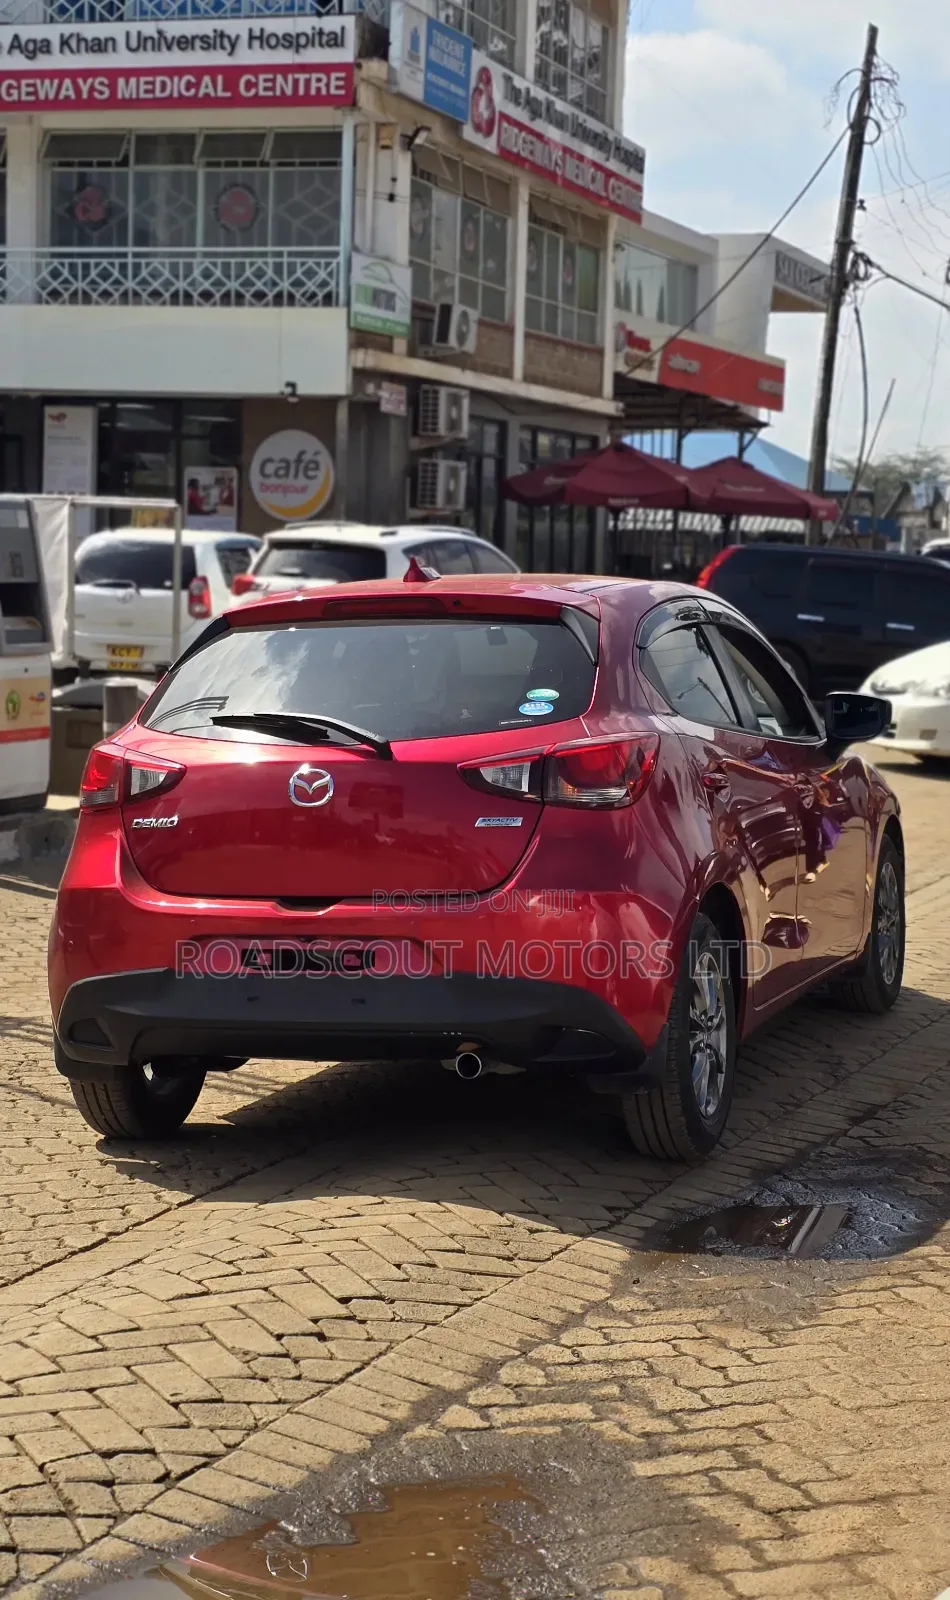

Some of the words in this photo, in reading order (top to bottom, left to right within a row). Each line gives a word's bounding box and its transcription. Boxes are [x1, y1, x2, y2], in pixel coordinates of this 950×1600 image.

[7, 33, 51, 60] Aga
[59, 33, 116, 54] Khan
[125, 28, 240, 56] University
[248, 26, 346, 54] Hospital
[117, 75, 232, 99] MEDICAL
[238, 72, 346, 97] CENTRE
[502, 72, 523, 107] The
[523, 86, 544, 122] Aga
[544, 96, 570, 133] Khan
[570, 111, 613, 162] University
[612, 136, 645, 175] Hospital
[501, 120, 564, 177] RIDGEWAYS
[565, 154, 607, 197] MEDICAL
[259, 450, 321, 481] café
[260, 482, 309, 498] bonjour
[131, 815, 178, 828] DEMIO
